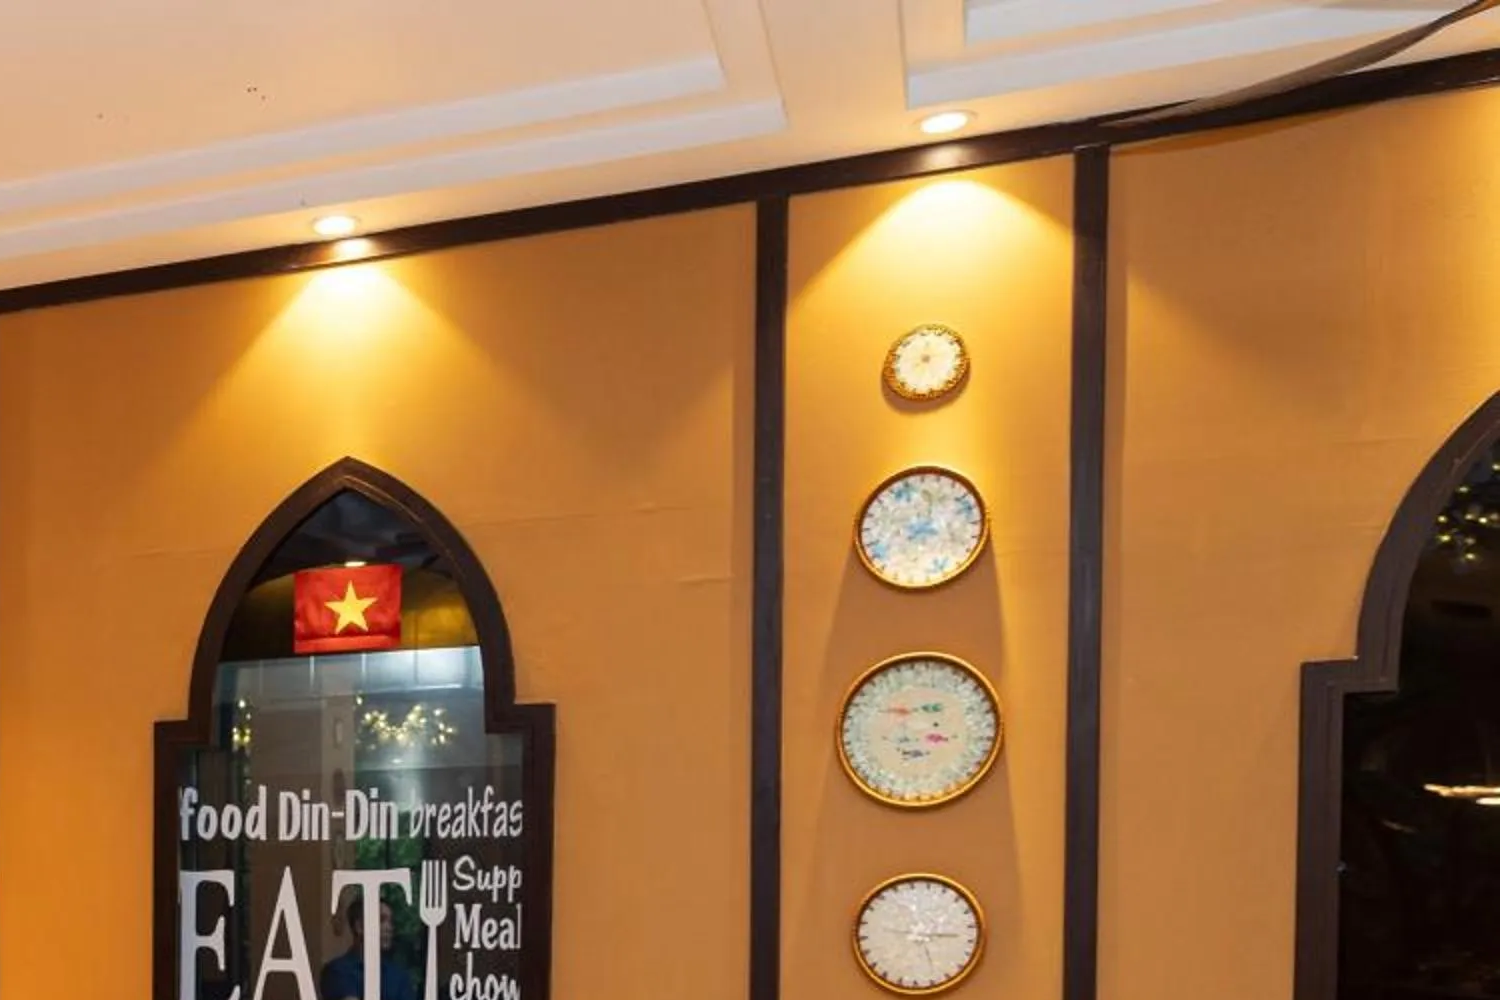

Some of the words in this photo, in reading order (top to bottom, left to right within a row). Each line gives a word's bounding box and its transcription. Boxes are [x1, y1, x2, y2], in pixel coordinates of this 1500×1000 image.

[179, 785, 267, 841] food
[278, 788, 399, 841] Din-Din
[408, 785, 523, 839] breakfas
[452, 855, 522, 903] Supp
